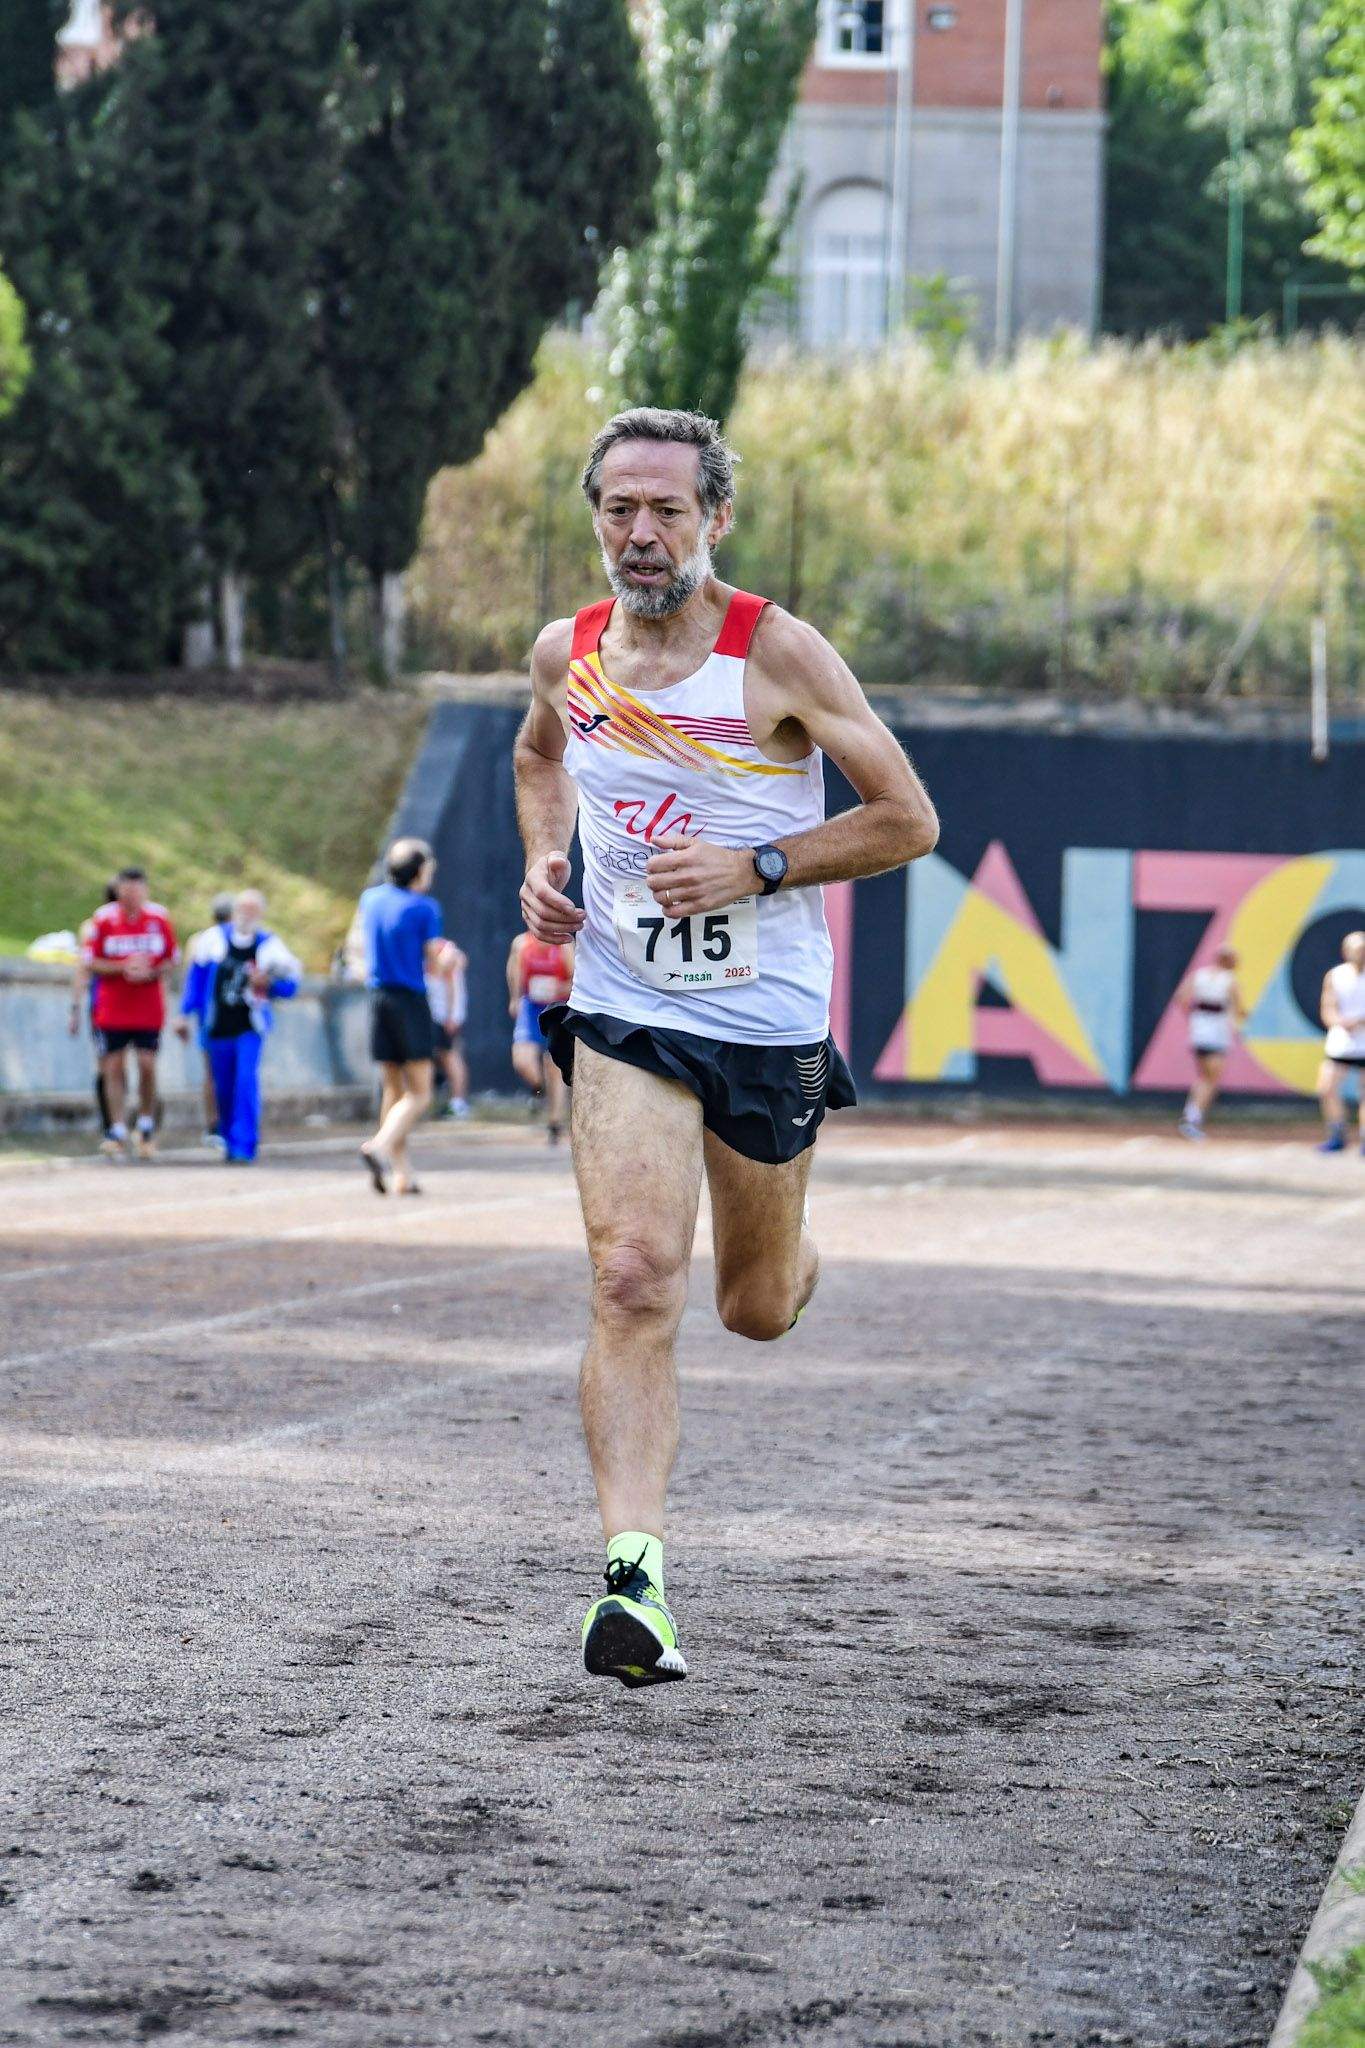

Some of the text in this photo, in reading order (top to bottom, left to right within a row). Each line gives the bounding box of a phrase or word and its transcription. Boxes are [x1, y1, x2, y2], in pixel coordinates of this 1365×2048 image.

[637, 914, 732, 963] 715
[684, 970, 712, 982] rasán
[724, 965, 752, 978] 2023
